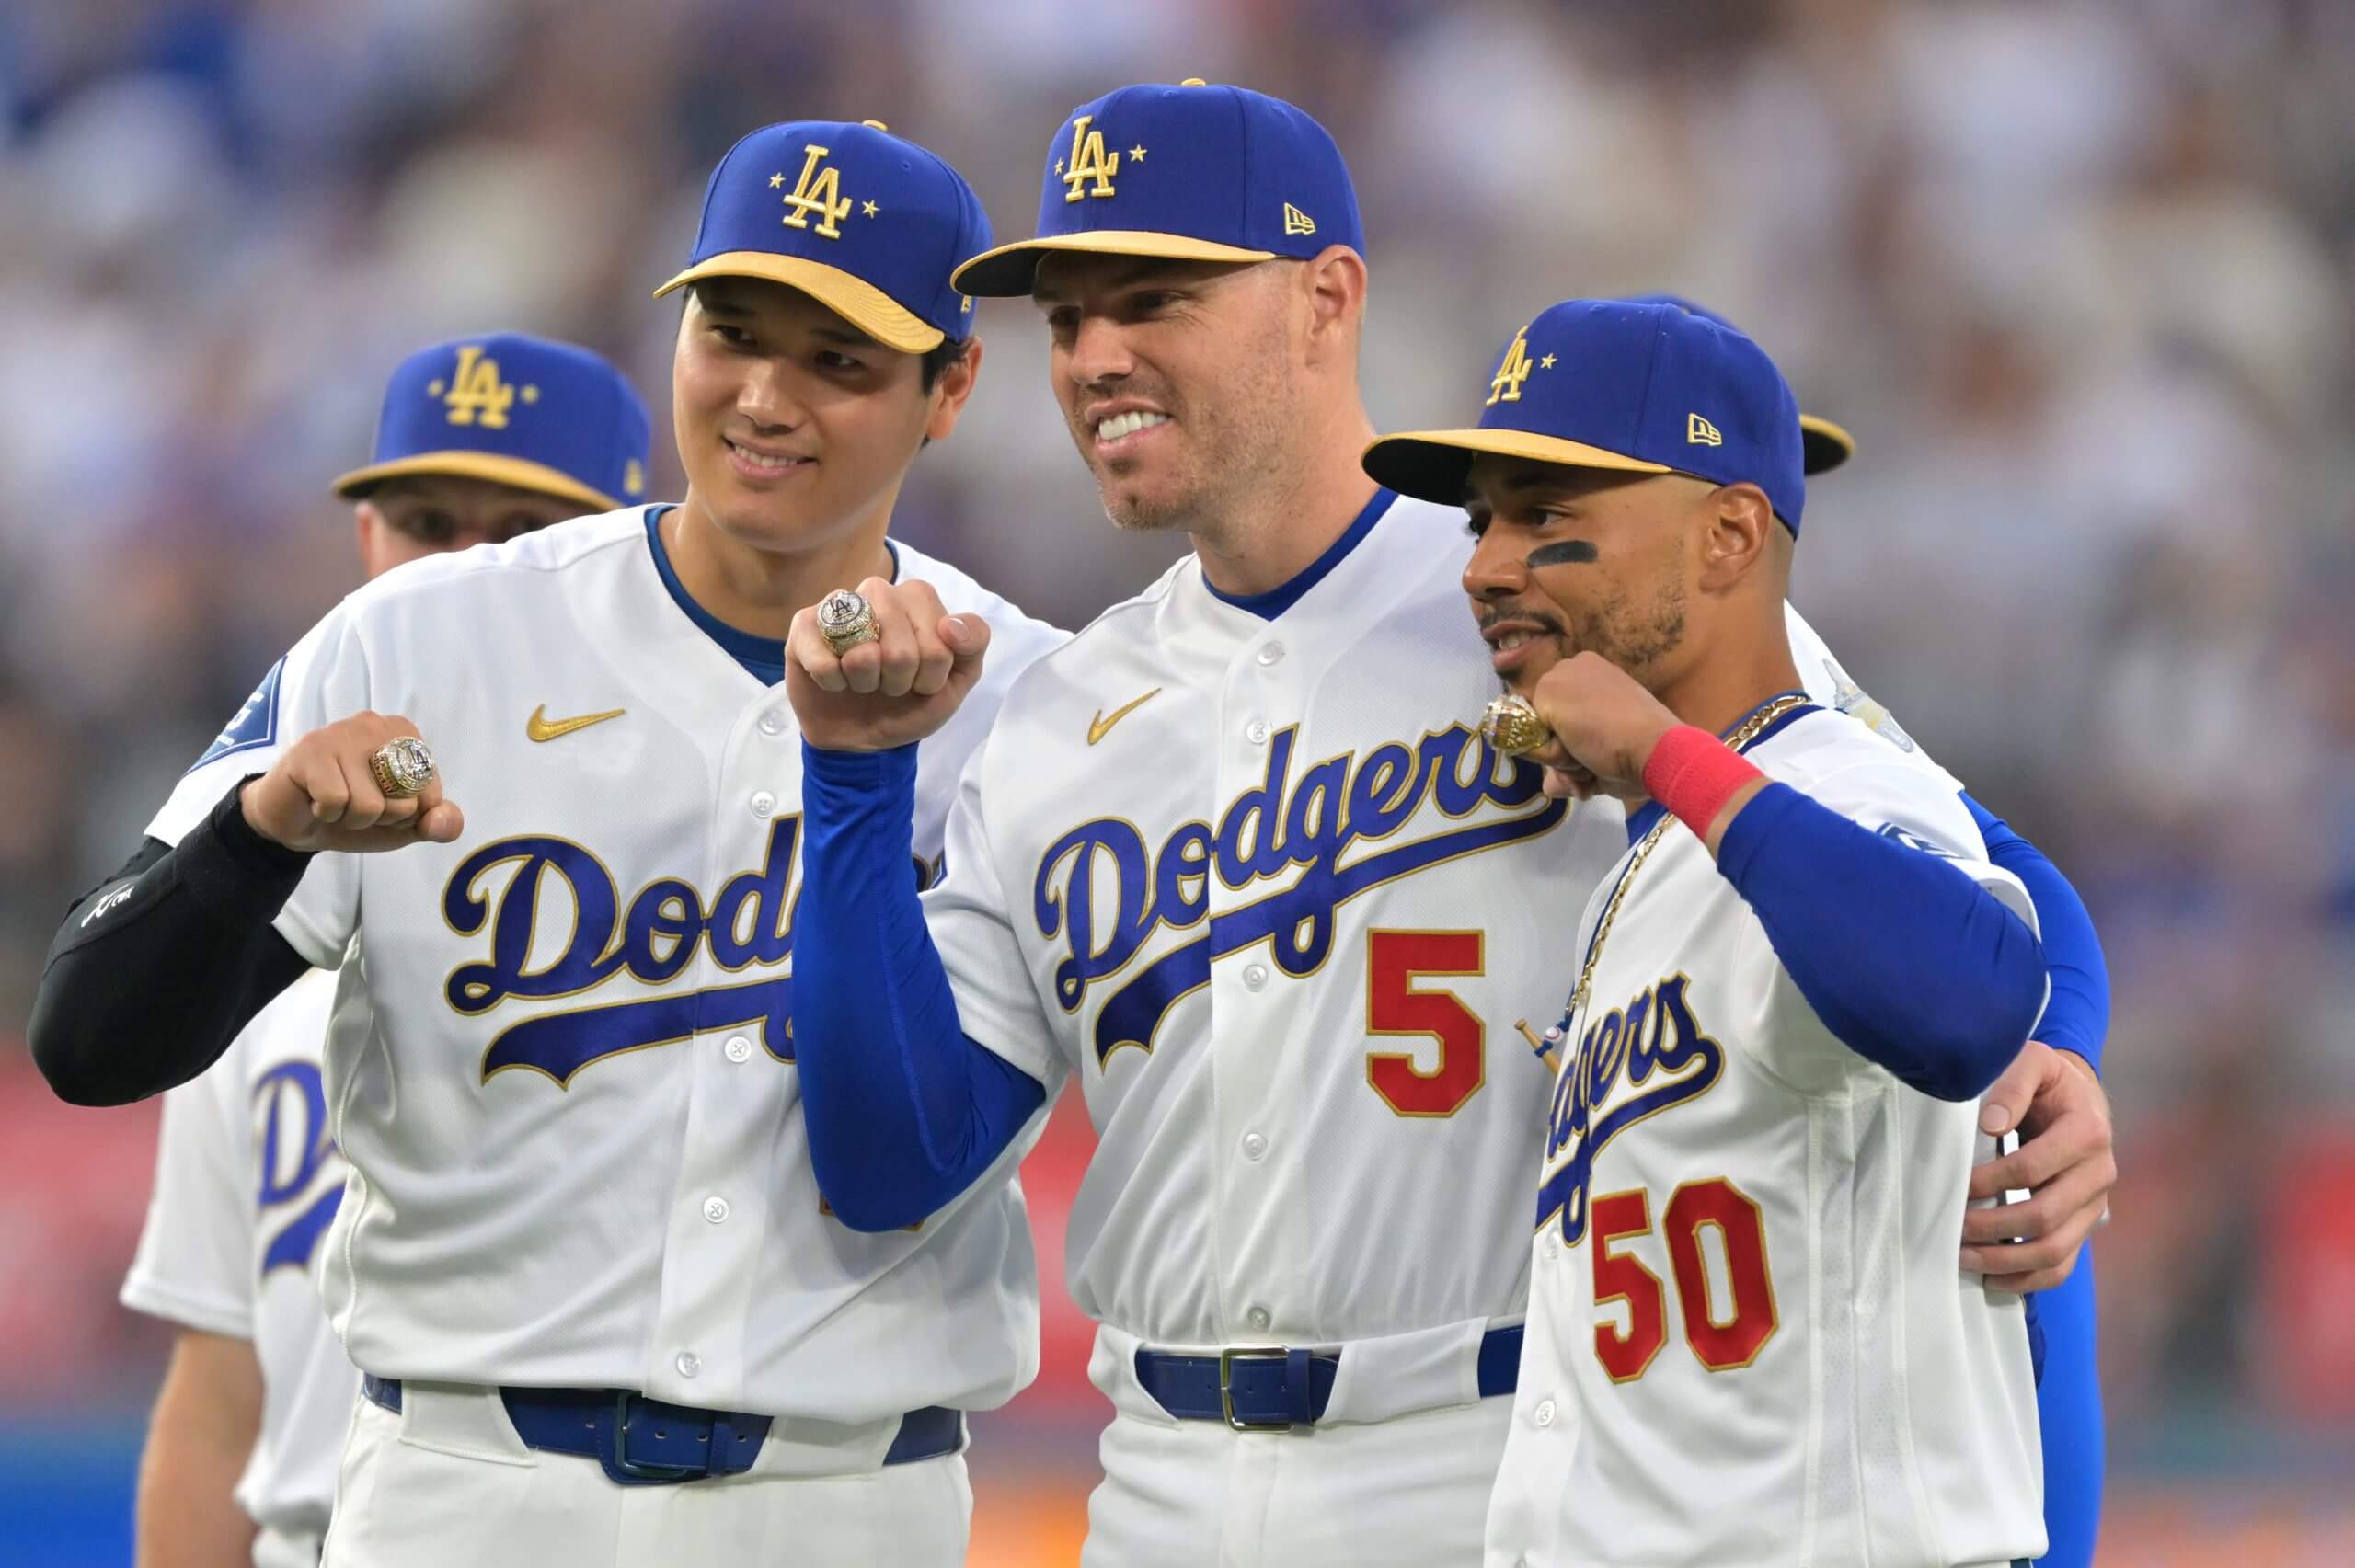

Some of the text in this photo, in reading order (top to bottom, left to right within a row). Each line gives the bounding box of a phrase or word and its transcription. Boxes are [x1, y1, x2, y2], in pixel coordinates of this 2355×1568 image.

[783, 144, 853, 240] LA
[1063, 115, 1119, 202] LA
[444, 346, 515, 429] LA
[1367, 928, 1486, 1117] 5
[1591, 1176, 1780, 1385] 50
